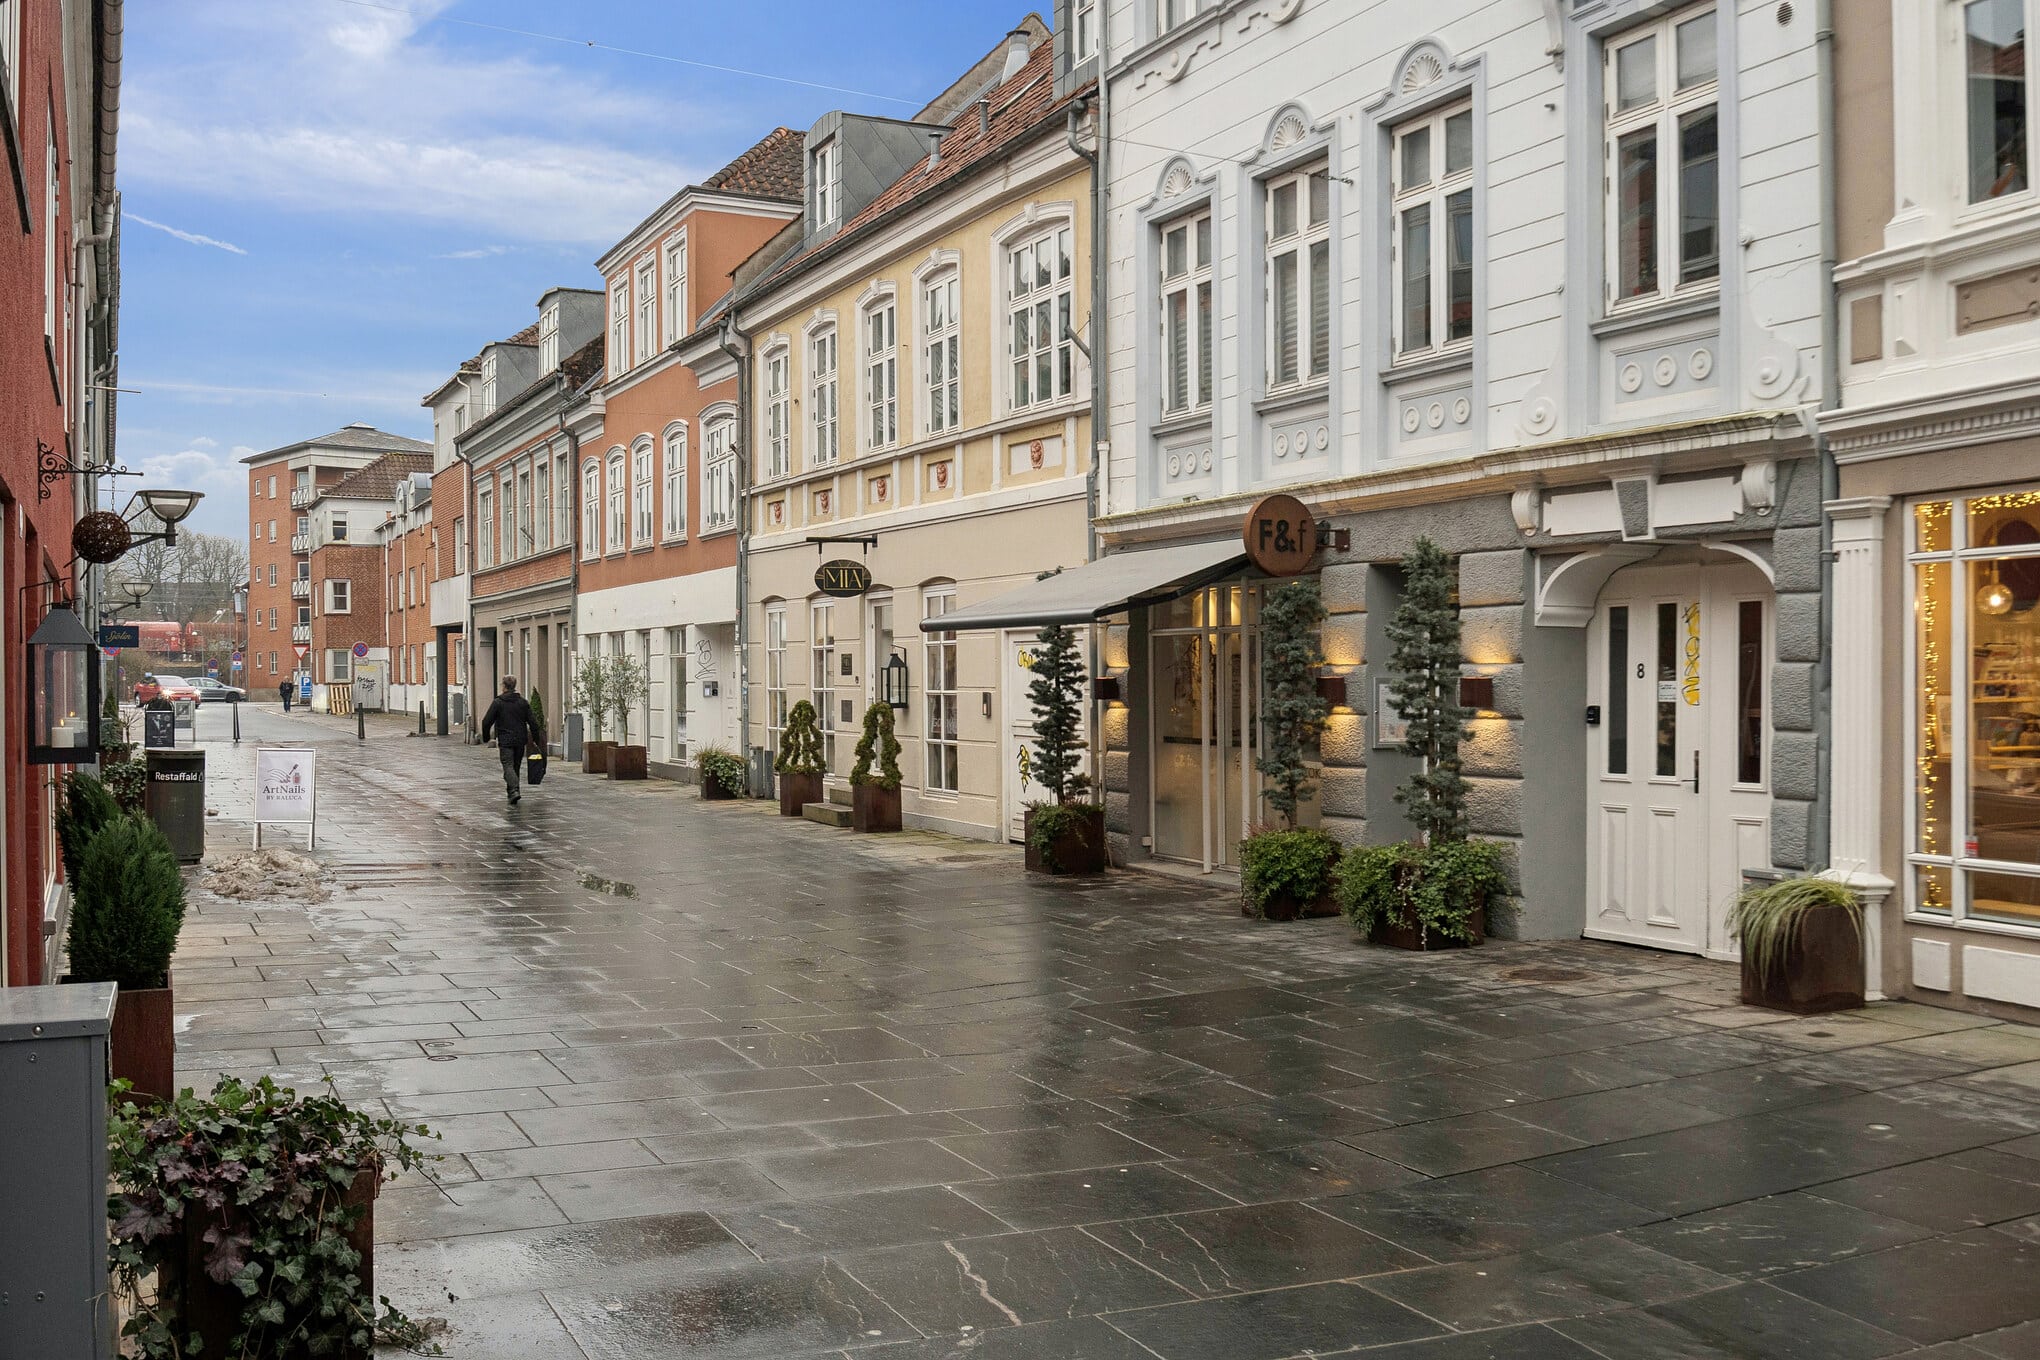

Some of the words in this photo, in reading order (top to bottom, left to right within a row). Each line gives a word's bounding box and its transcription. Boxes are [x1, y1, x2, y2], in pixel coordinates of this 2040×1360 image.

[1260, 519, 1307, 552] F&f
[825, 569, 862, 588] MIA
[1637, 663, 1645, 679] 8
[303, 677, 310, 686] P
[155, 771, 198, 781] Restaffald
[262, 785, 306, 794] ArtNails
